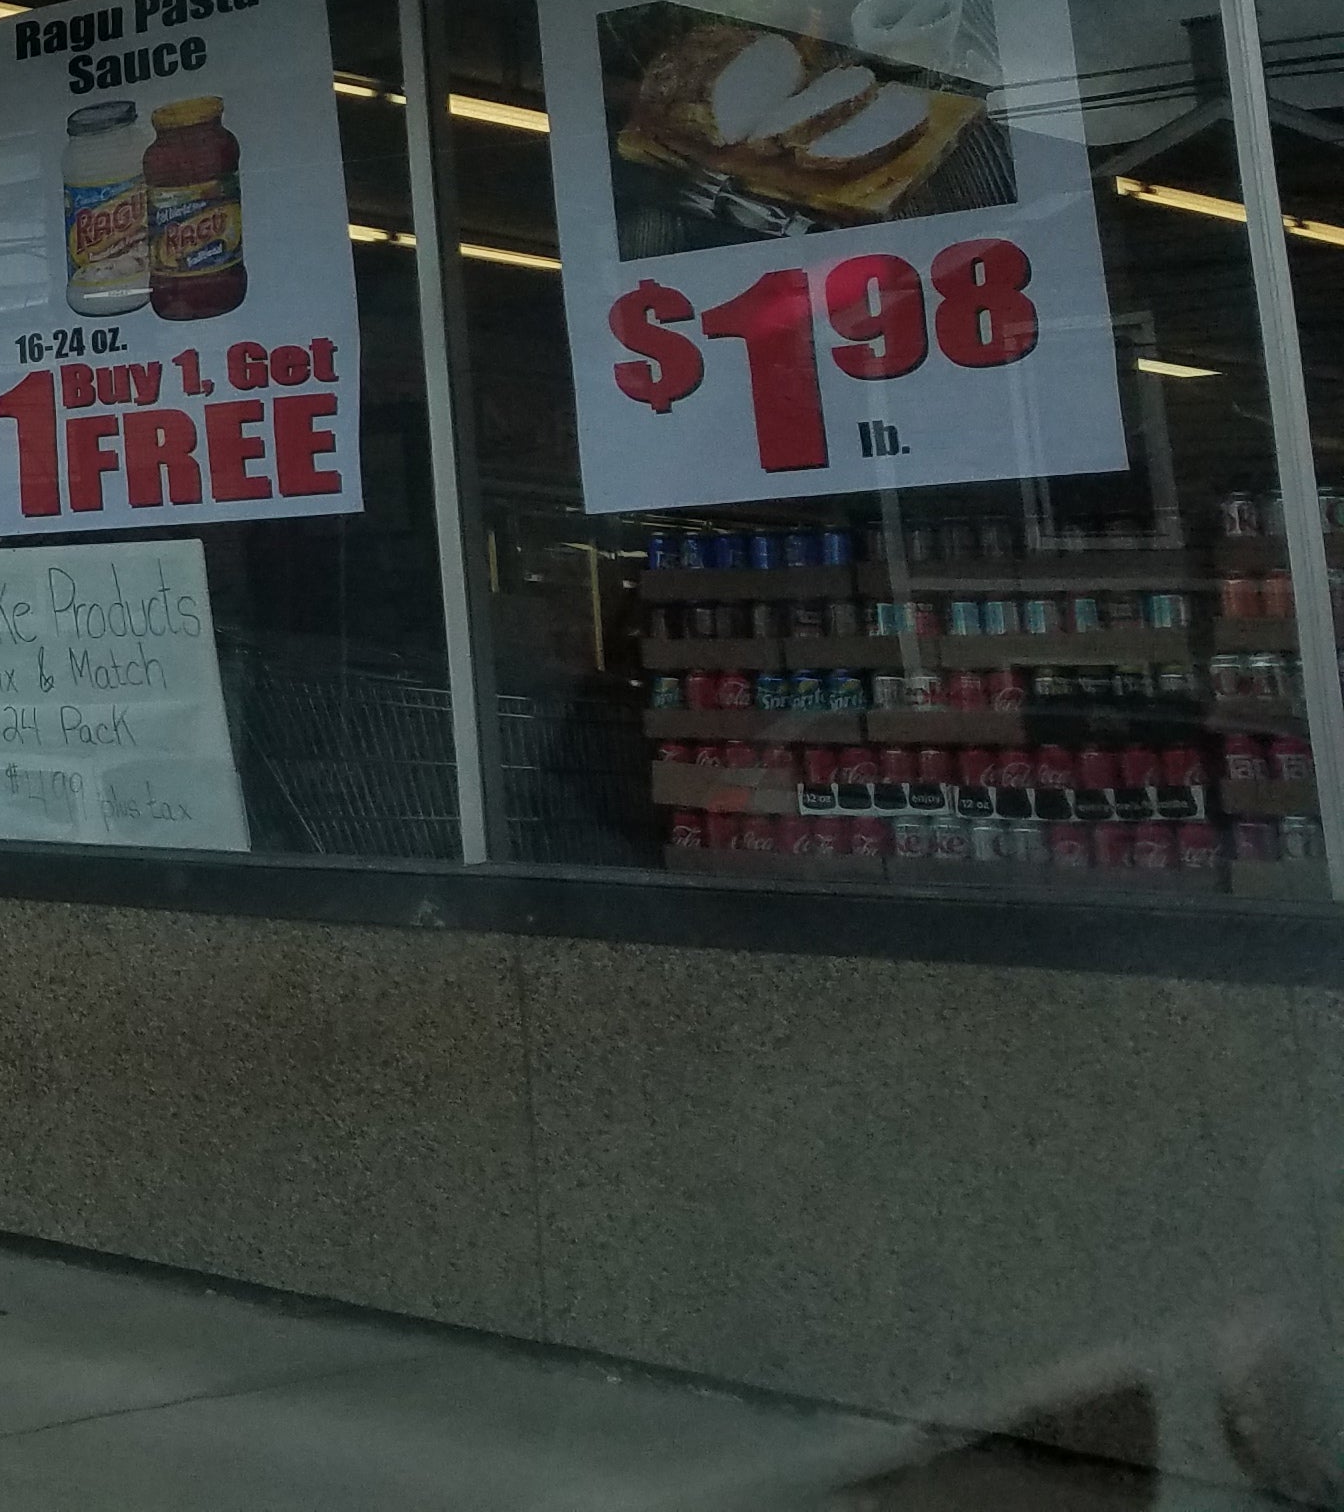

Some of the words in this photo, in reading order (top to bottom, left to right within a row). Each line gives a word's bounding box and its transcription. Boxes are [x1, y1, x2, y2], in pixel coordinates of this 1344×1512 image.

[15, 0, 123, 60] Ragu
[68, 34, 207, 95] Sauce
[15, 330, 85, 364] 16-24
[62, 362, 162, 408] Buy
[226, 337, 338, 390] Get
[66, 393, 342, 513] FREE
[857, 420, 911, 459] lb.
[48, 559, 201, 642] Products
[69, 639, 167, 691] Match
[2, 705, 40, 744] 24
[59, 705, 139, 748] Pack
[145, 780, 193, 821] tax
